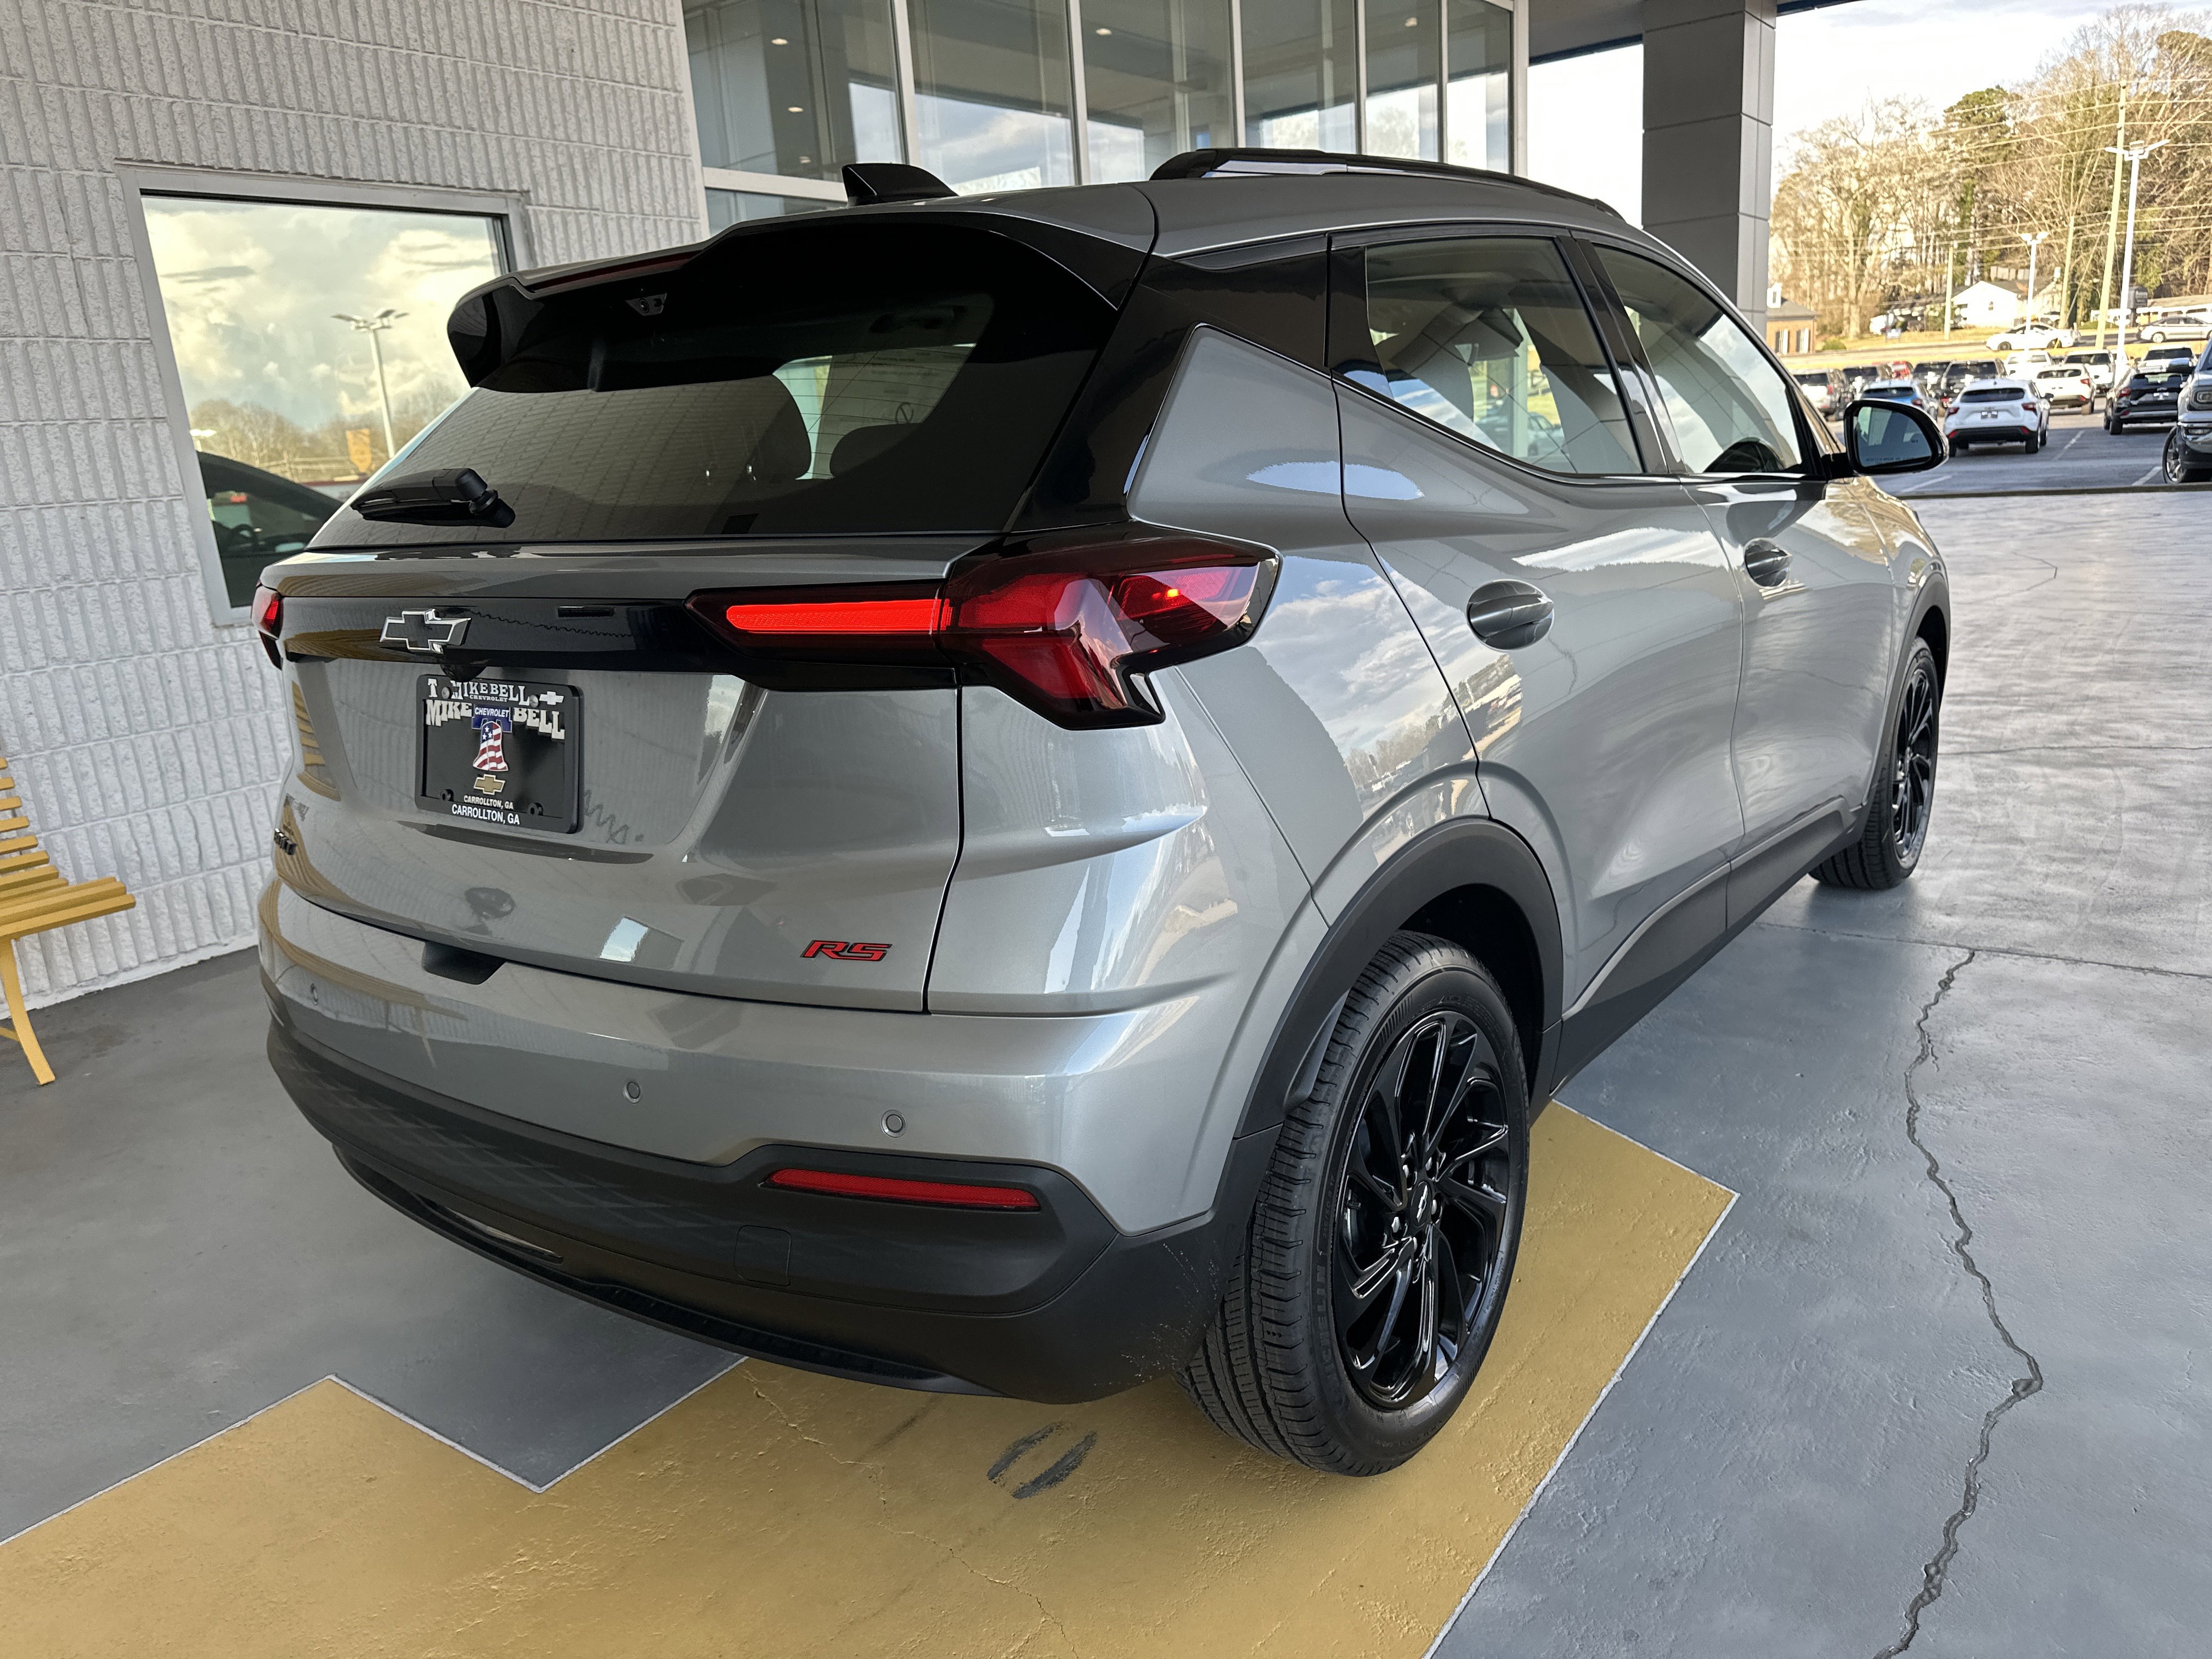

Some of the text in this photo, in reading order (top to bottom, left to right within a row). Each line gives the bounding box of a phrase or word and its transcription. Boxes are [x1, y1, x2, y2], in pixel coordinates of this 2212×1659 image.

[450, 680, 531, 706] MIKE BELL
[469, 694, 509, 702] CHEVROLET
[426, 699, 565, 740] MIKE BELL
[475, 707, 510, 718] CHEVROLET
[464, 795, 514, 810] CARROLLTON, GA
[452, 804, 520, 825] CARROLLTON, GA
[799, 940, 893, 962] RS
[1317, 1265, 1340, 1392] ICHELIN
